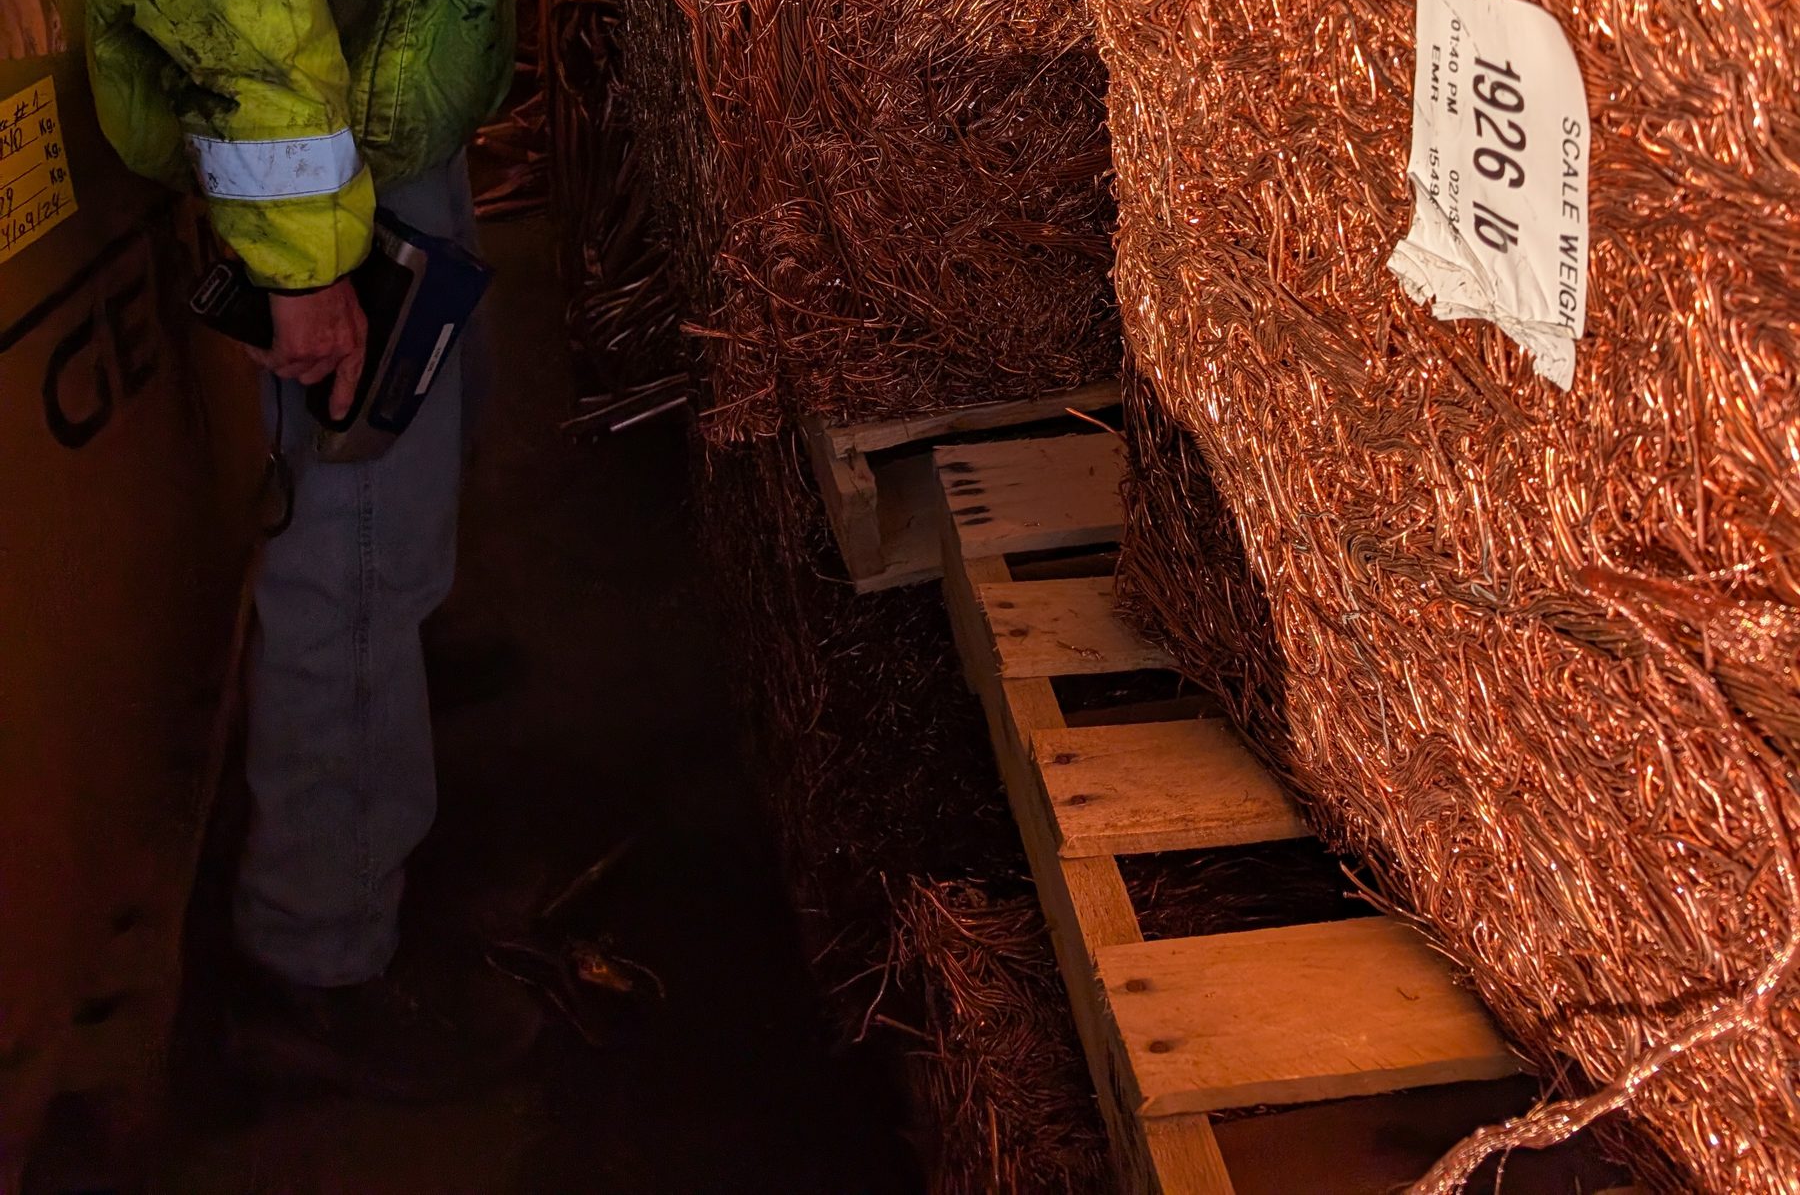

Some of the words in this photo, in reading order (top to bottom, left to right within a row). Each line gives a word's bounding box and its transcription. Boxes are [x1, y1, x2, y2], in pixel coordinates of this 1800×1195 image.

[1430, 44, 1442, 103] EMR
[1447, 18, 1460, 75] 01:40
[1446, 80, 1459, 117] PM
[1472, 56, 1527, 189] 1926
[1428, 146, 1441, 205] 1549
[1561, 116, 1581, 223] SCALE
[1472, 200, 1520, 255] lb
[1558, 233, 1580, 338] WEIGH
